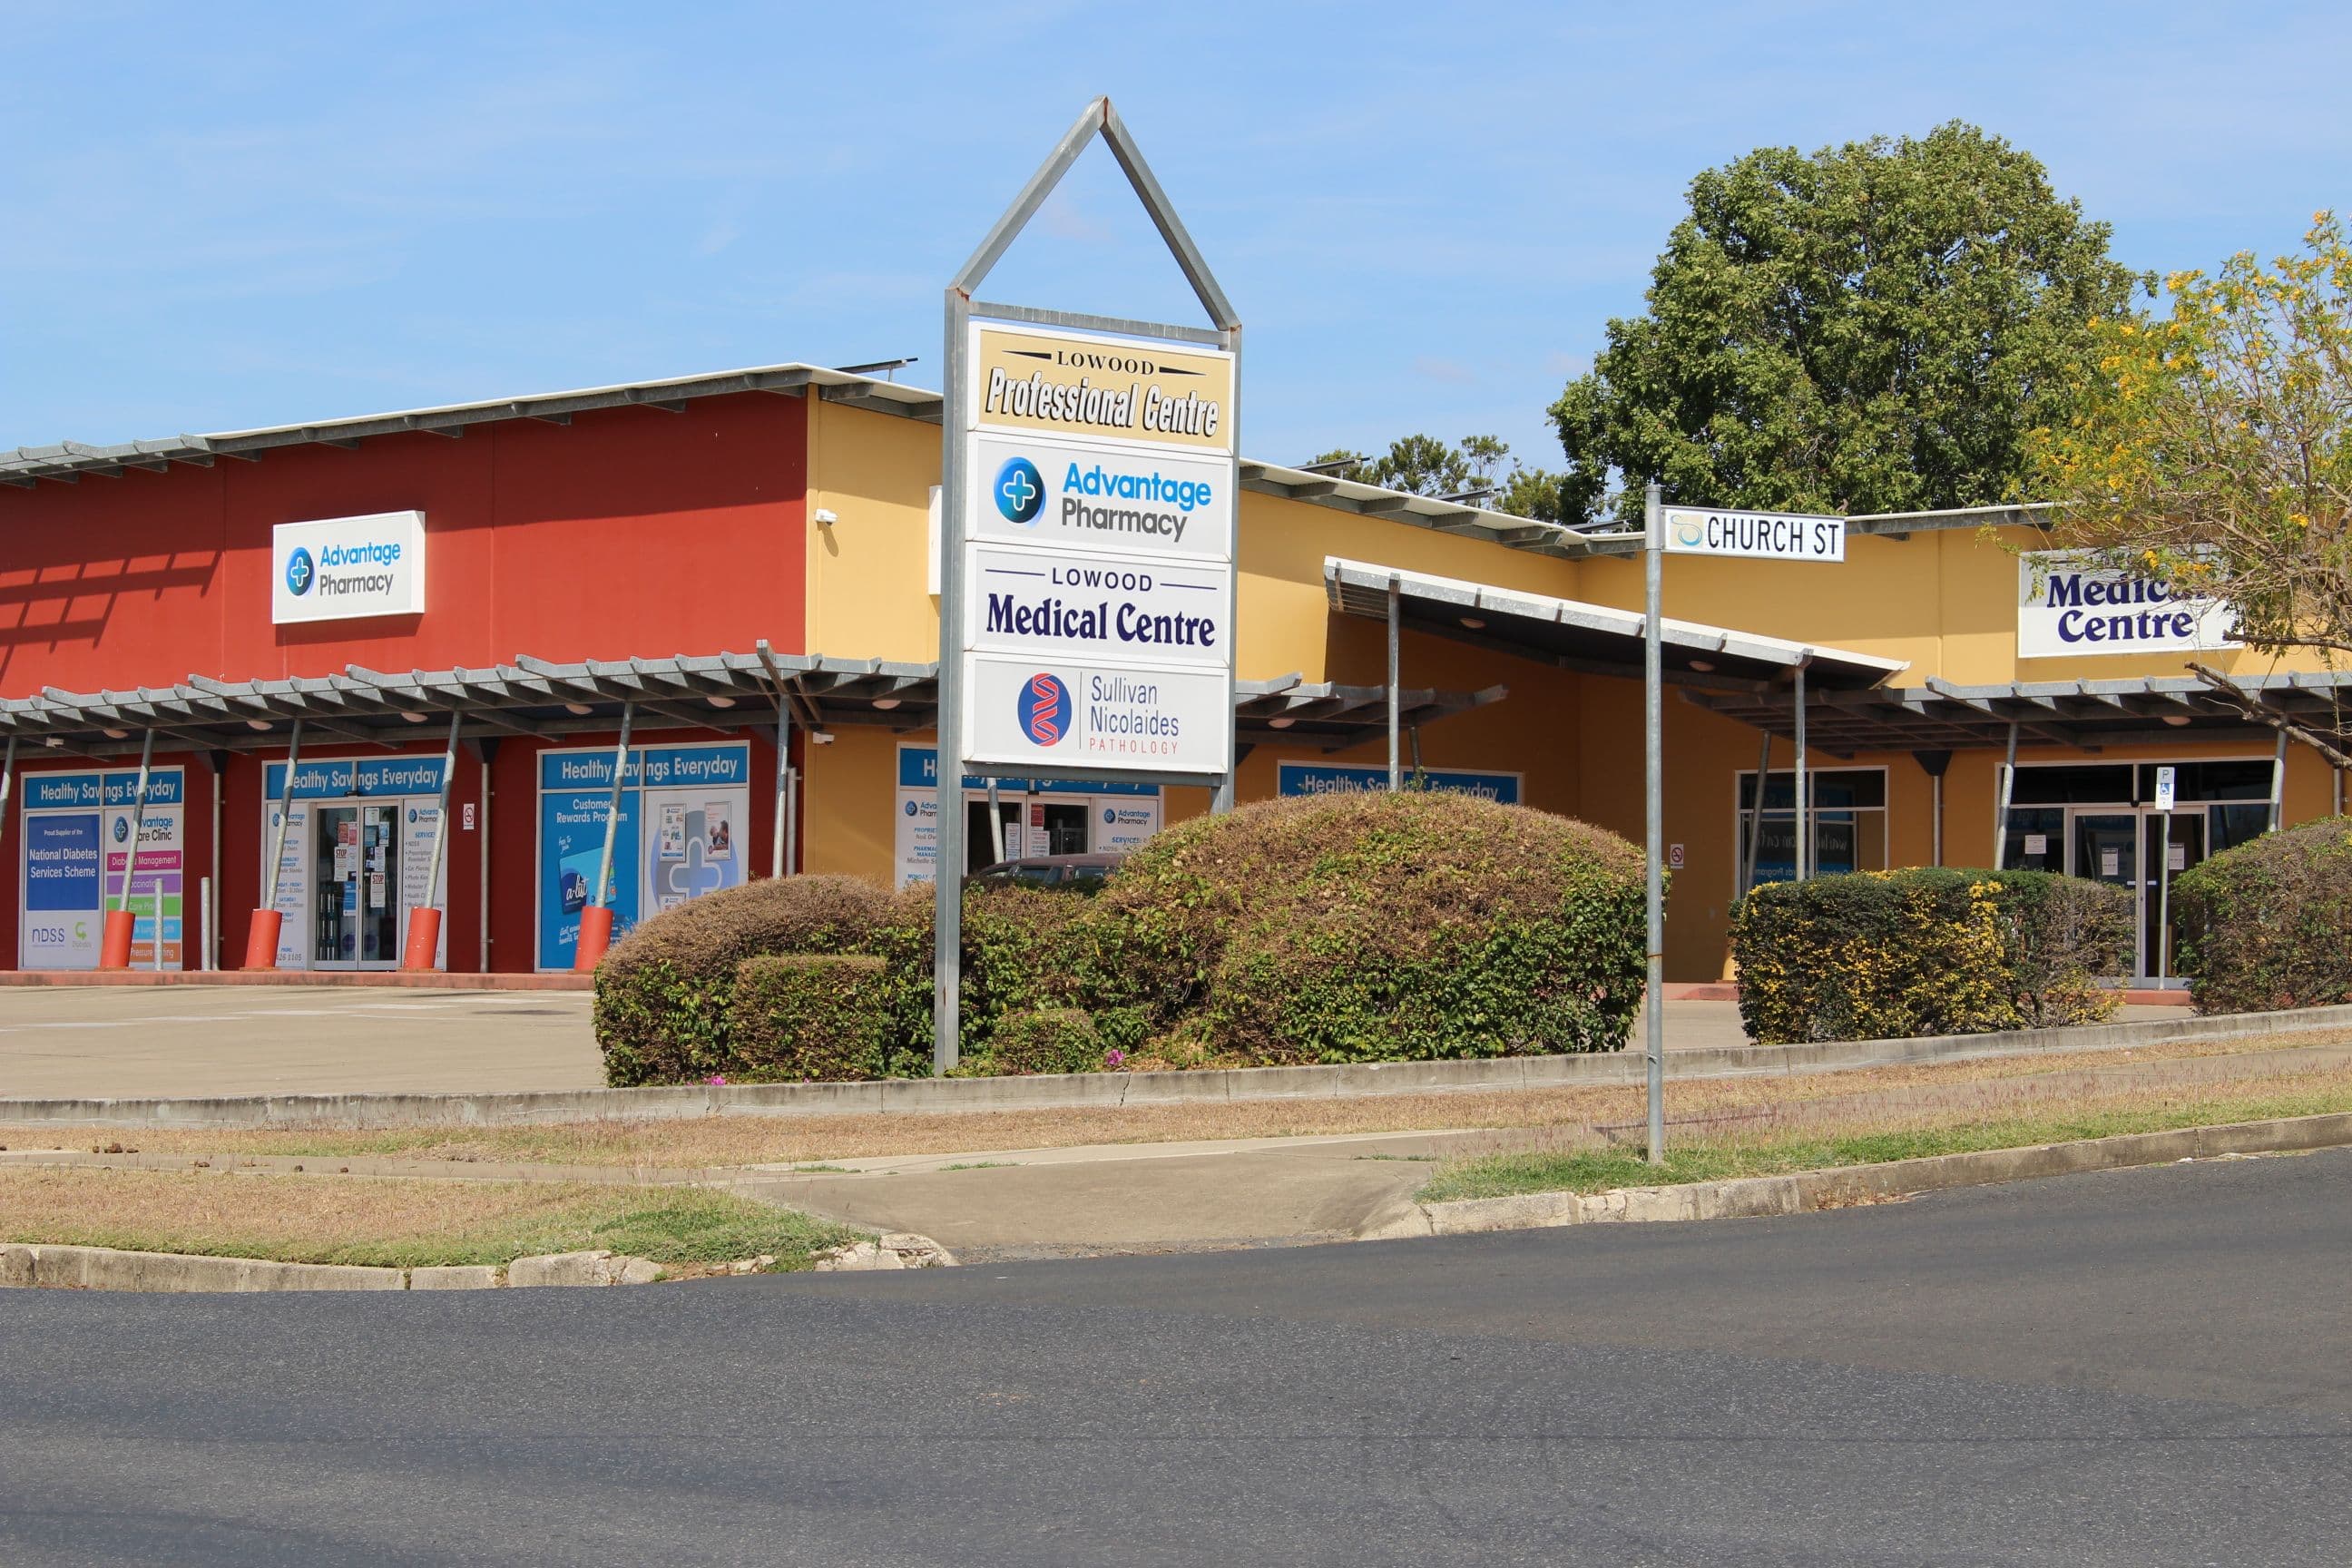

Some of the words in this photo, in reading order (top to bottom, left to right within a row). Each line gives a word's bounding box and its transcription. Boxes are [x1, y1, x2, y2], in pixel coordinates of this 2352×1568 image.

[1057, 351, 1154, 376] LOWOOD
[985, 368, 1140, 427] Professional
[1142, 385, 1220, 436] Centre
[1063, 463, 1211, 512] Advantage
[1062, 498, 1187, 543] Pharmacy
[1708, 516, 1803, 553] CHURCH
[1813, 524, 1839, 554] ST
[319, 542, 401, 566] Advantage
[319, 573, 394, 596] Pharmacy
[1053, 567, 1152, 592] LOWOOD
[2047, 573, 2207, 608] Medic
[986, 593, 1108, 640] Medical
[1116, 603, 1215, 647] Centre
[2058, 610, 2194, 642] Centre
[1092, 675, 1158, 704] Sullivan
[1091, 706, 1179, 736] Nicolaides
[1090, 738, 1179, 755] PATHOLOGY
[293, 770, 328, 791] ealthy
[332, 770, 378, 790] Savngs
[383, 766, 437, 789] Everyday
[562, 760, 612, 782] Healthy
[620, 762, 670, 781] avngs
[674, 755, 738, 779] Everyday
[2162, 769, 2170, 779] P
[41, 782, 79, 803] Healthy
[83, 782, 123, 803] Savngs
[127, 779, 175, 800] Evryday
[1305, 775, 1361, 793] Healthy
[141, 817, 173, 830] vantage
[557, 811, 591, 823] Rewards
[1118, 809, 1151, 818] Advantage
[1118, 818, 1147, 826] Pharmacy
[152, 828, 172, 841] Clinic
[29, 848, 61, 861] National
[63, 848, 97, 860] Diabetes
[138, 856, 177, 867] Management
[336, 849, 347, 858] STOP
[30, 867, 63, 878] Services
[64, 866, 95, 877] Scheme
[373, 875, 384, 884] STOP
